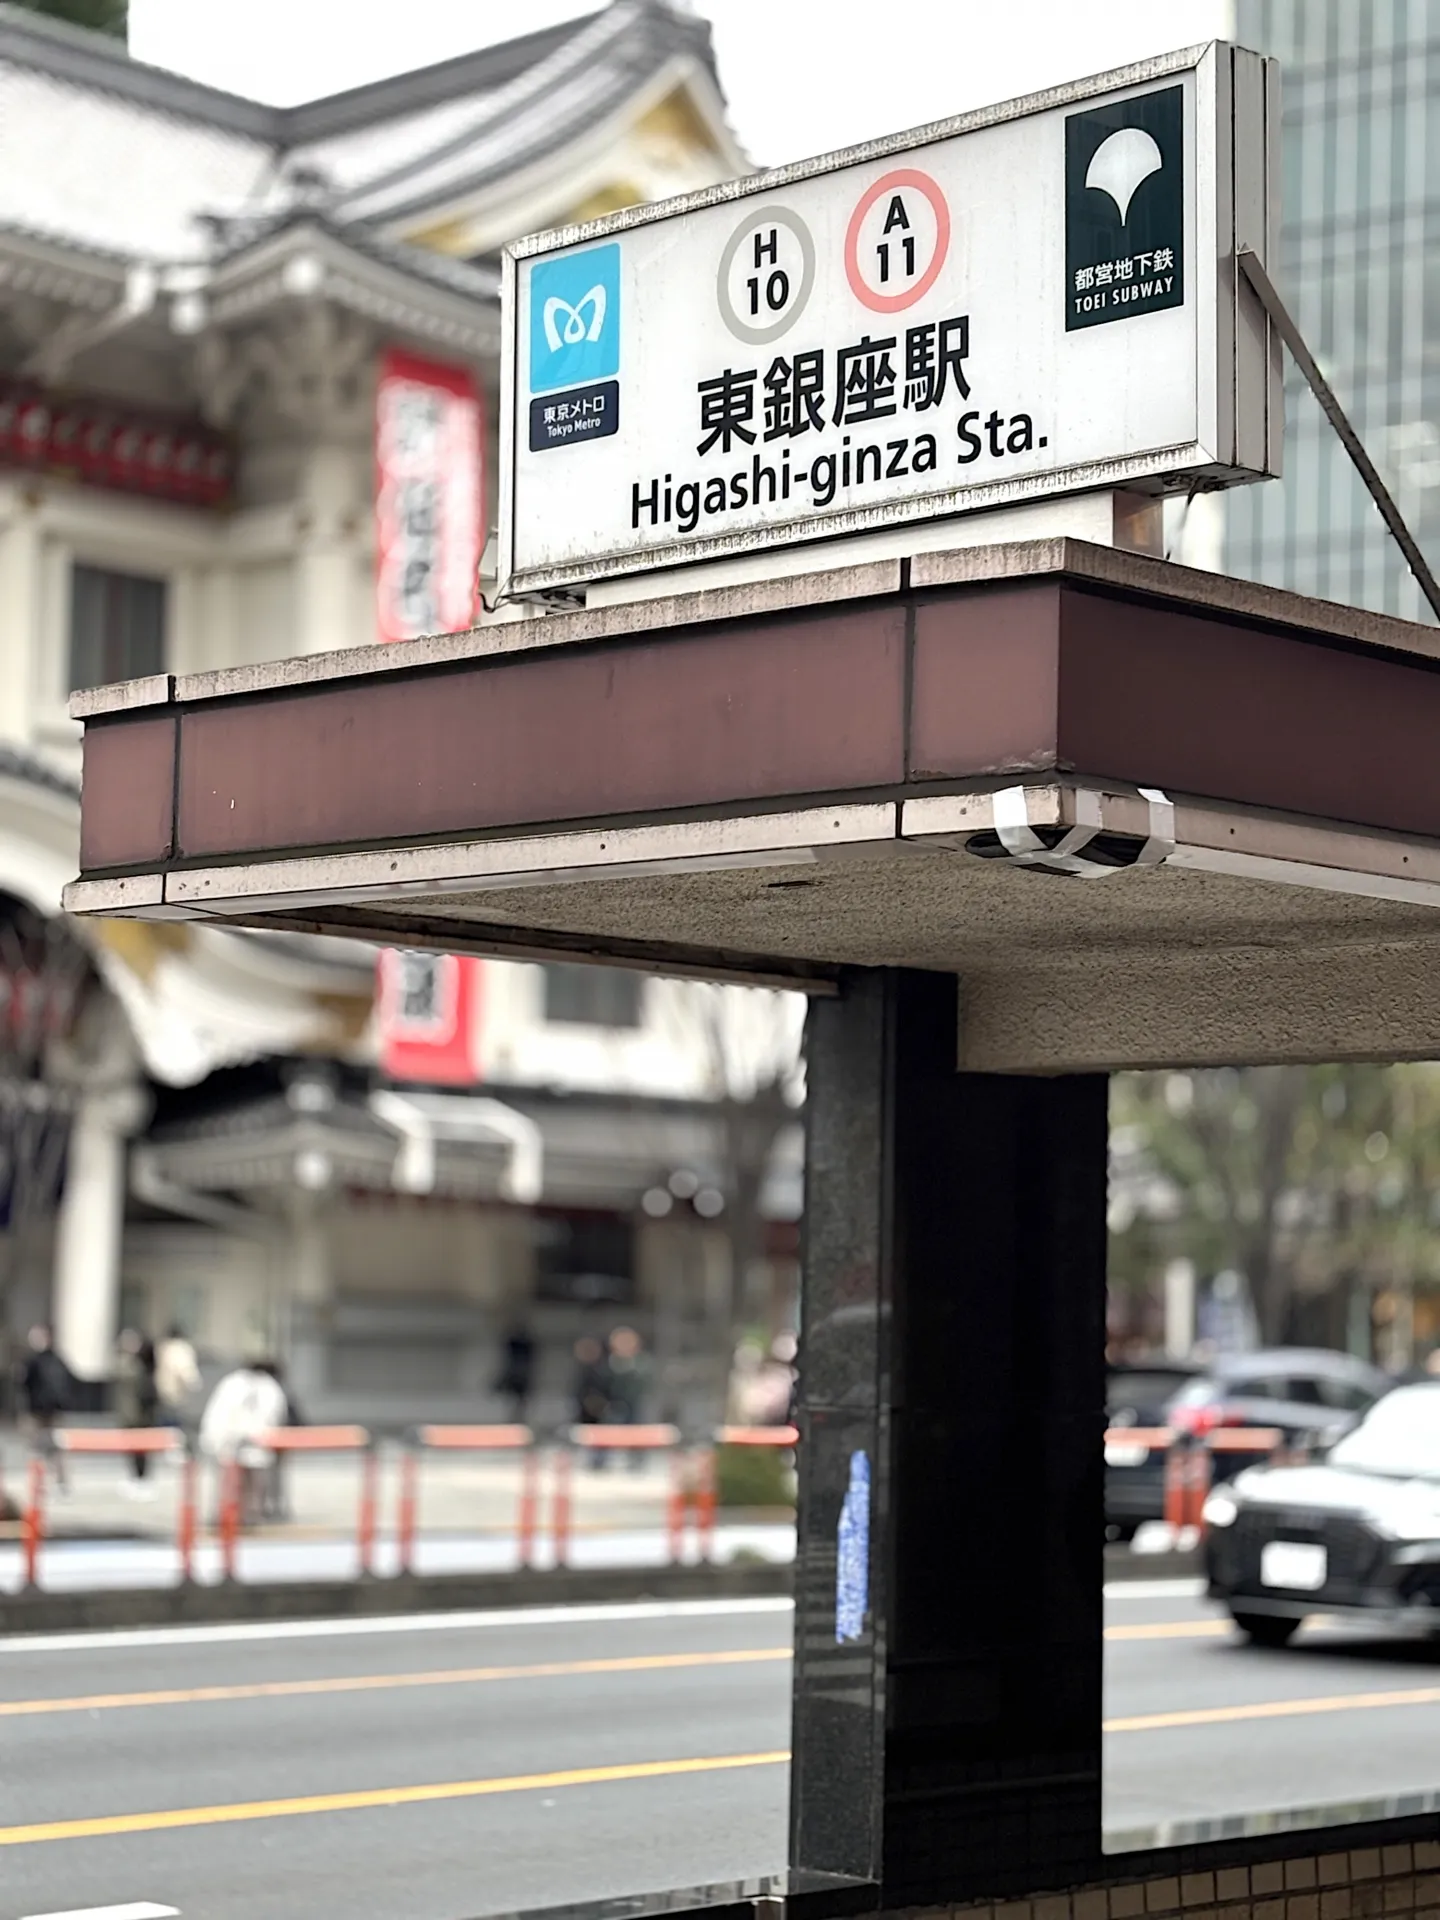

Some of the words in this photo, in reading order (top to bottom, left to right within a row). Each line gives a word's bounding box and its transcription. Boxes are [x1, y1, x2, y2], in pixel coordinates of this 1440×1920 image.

[883, 195, 910, 235] A
[753, 228, 777, 269] H
[876, 236, 915, 283] 11
[1075, 247, 1174, 291] 都営地下鉄
[747, 269, 789, 315] 10
[1075, 292, 1106, 314] TOEI
[1112, 276, 1174, 305] SUBWAY
[696, 315, 971, 458] 東銀座駅
[543, 395, 605, 424] 東京メトロ
[547, 423, 573, 438] Tokyo
[574, 417, 601, 431] Metro
[631, 432, 937, 532] Higashi-ginza
[957, 410, 1049, 463] Sta.
